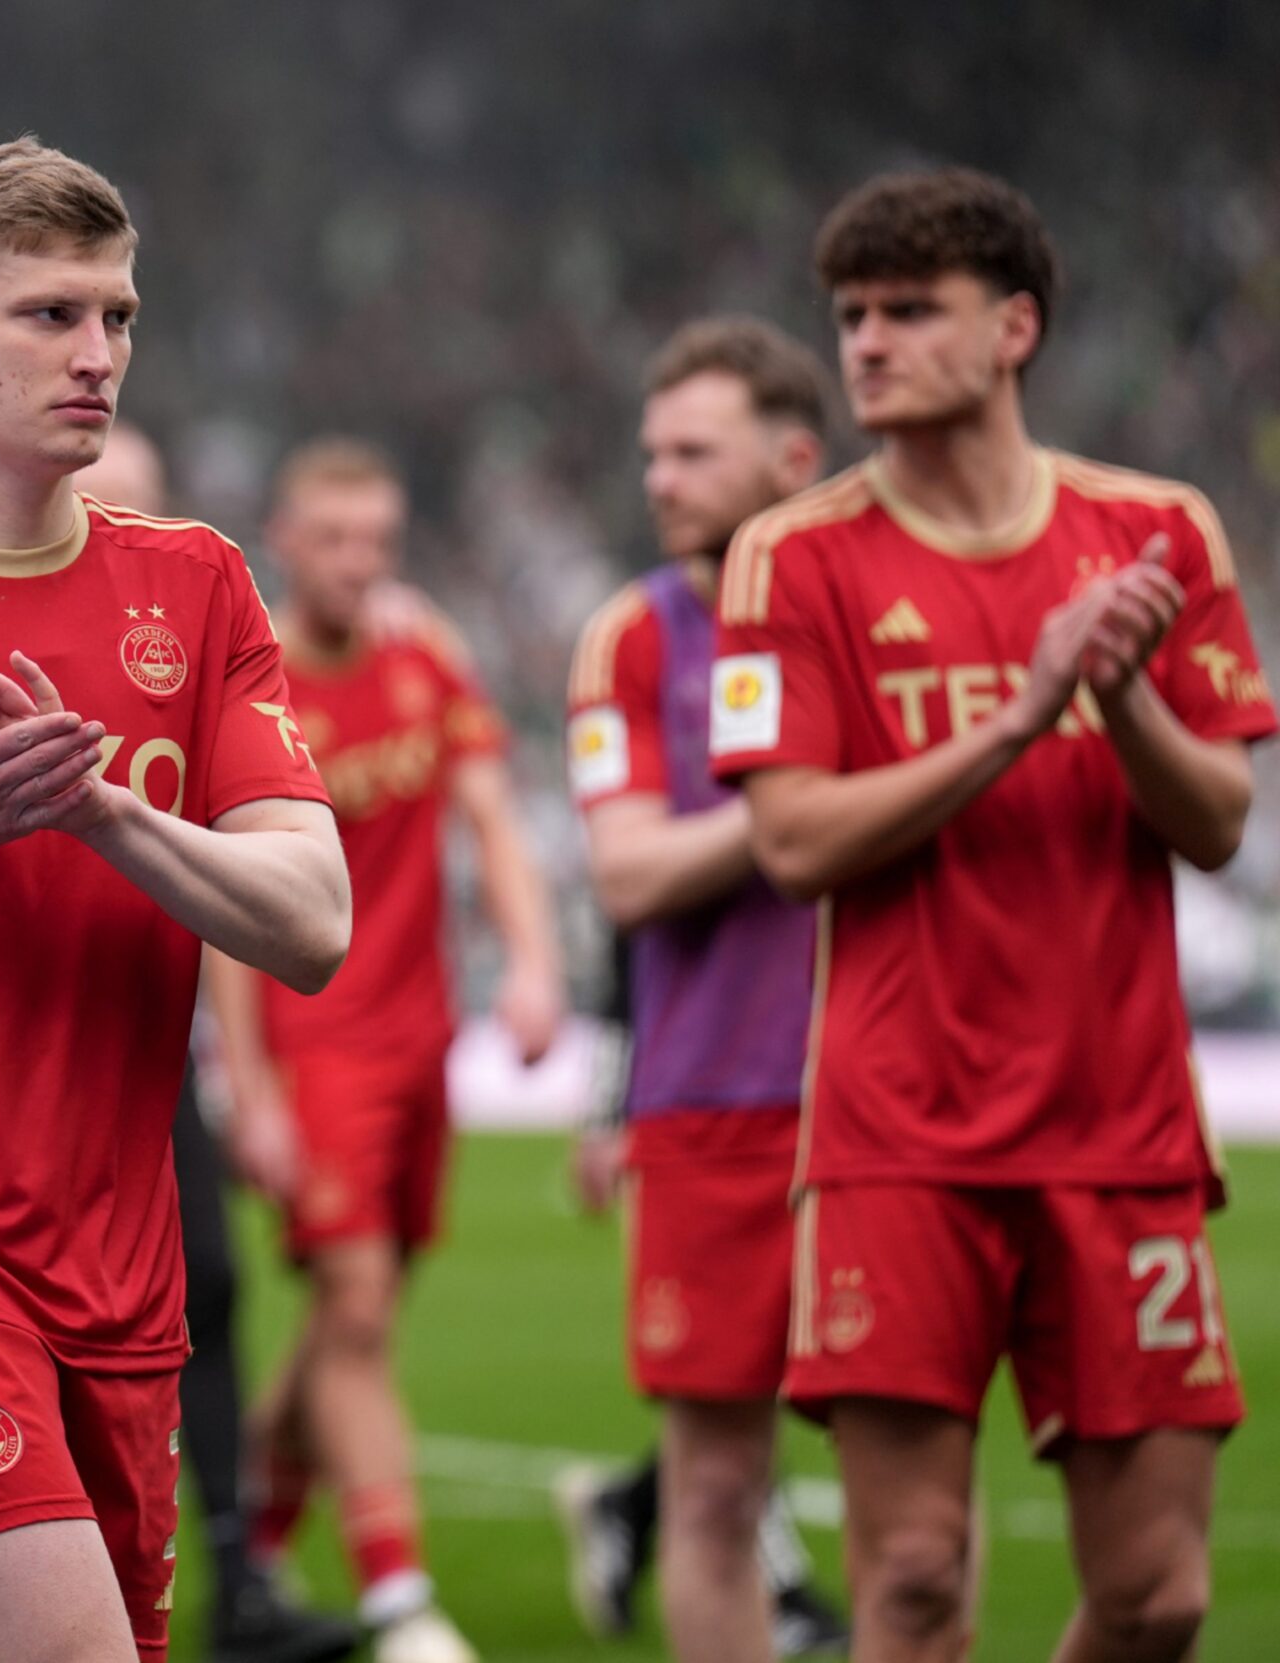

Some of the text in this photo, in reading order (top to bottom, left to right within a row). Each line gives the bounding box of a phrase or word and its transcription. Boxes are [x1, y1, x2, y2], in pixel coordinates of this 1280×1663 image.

[129, 628, 174, 646] ABERDEEN
[127, 661, 183, 690] FOOTBALL CLUB
[1128, 1236, 1223, 1351] 21
[4, 1435, 17, 1460] CLUB
